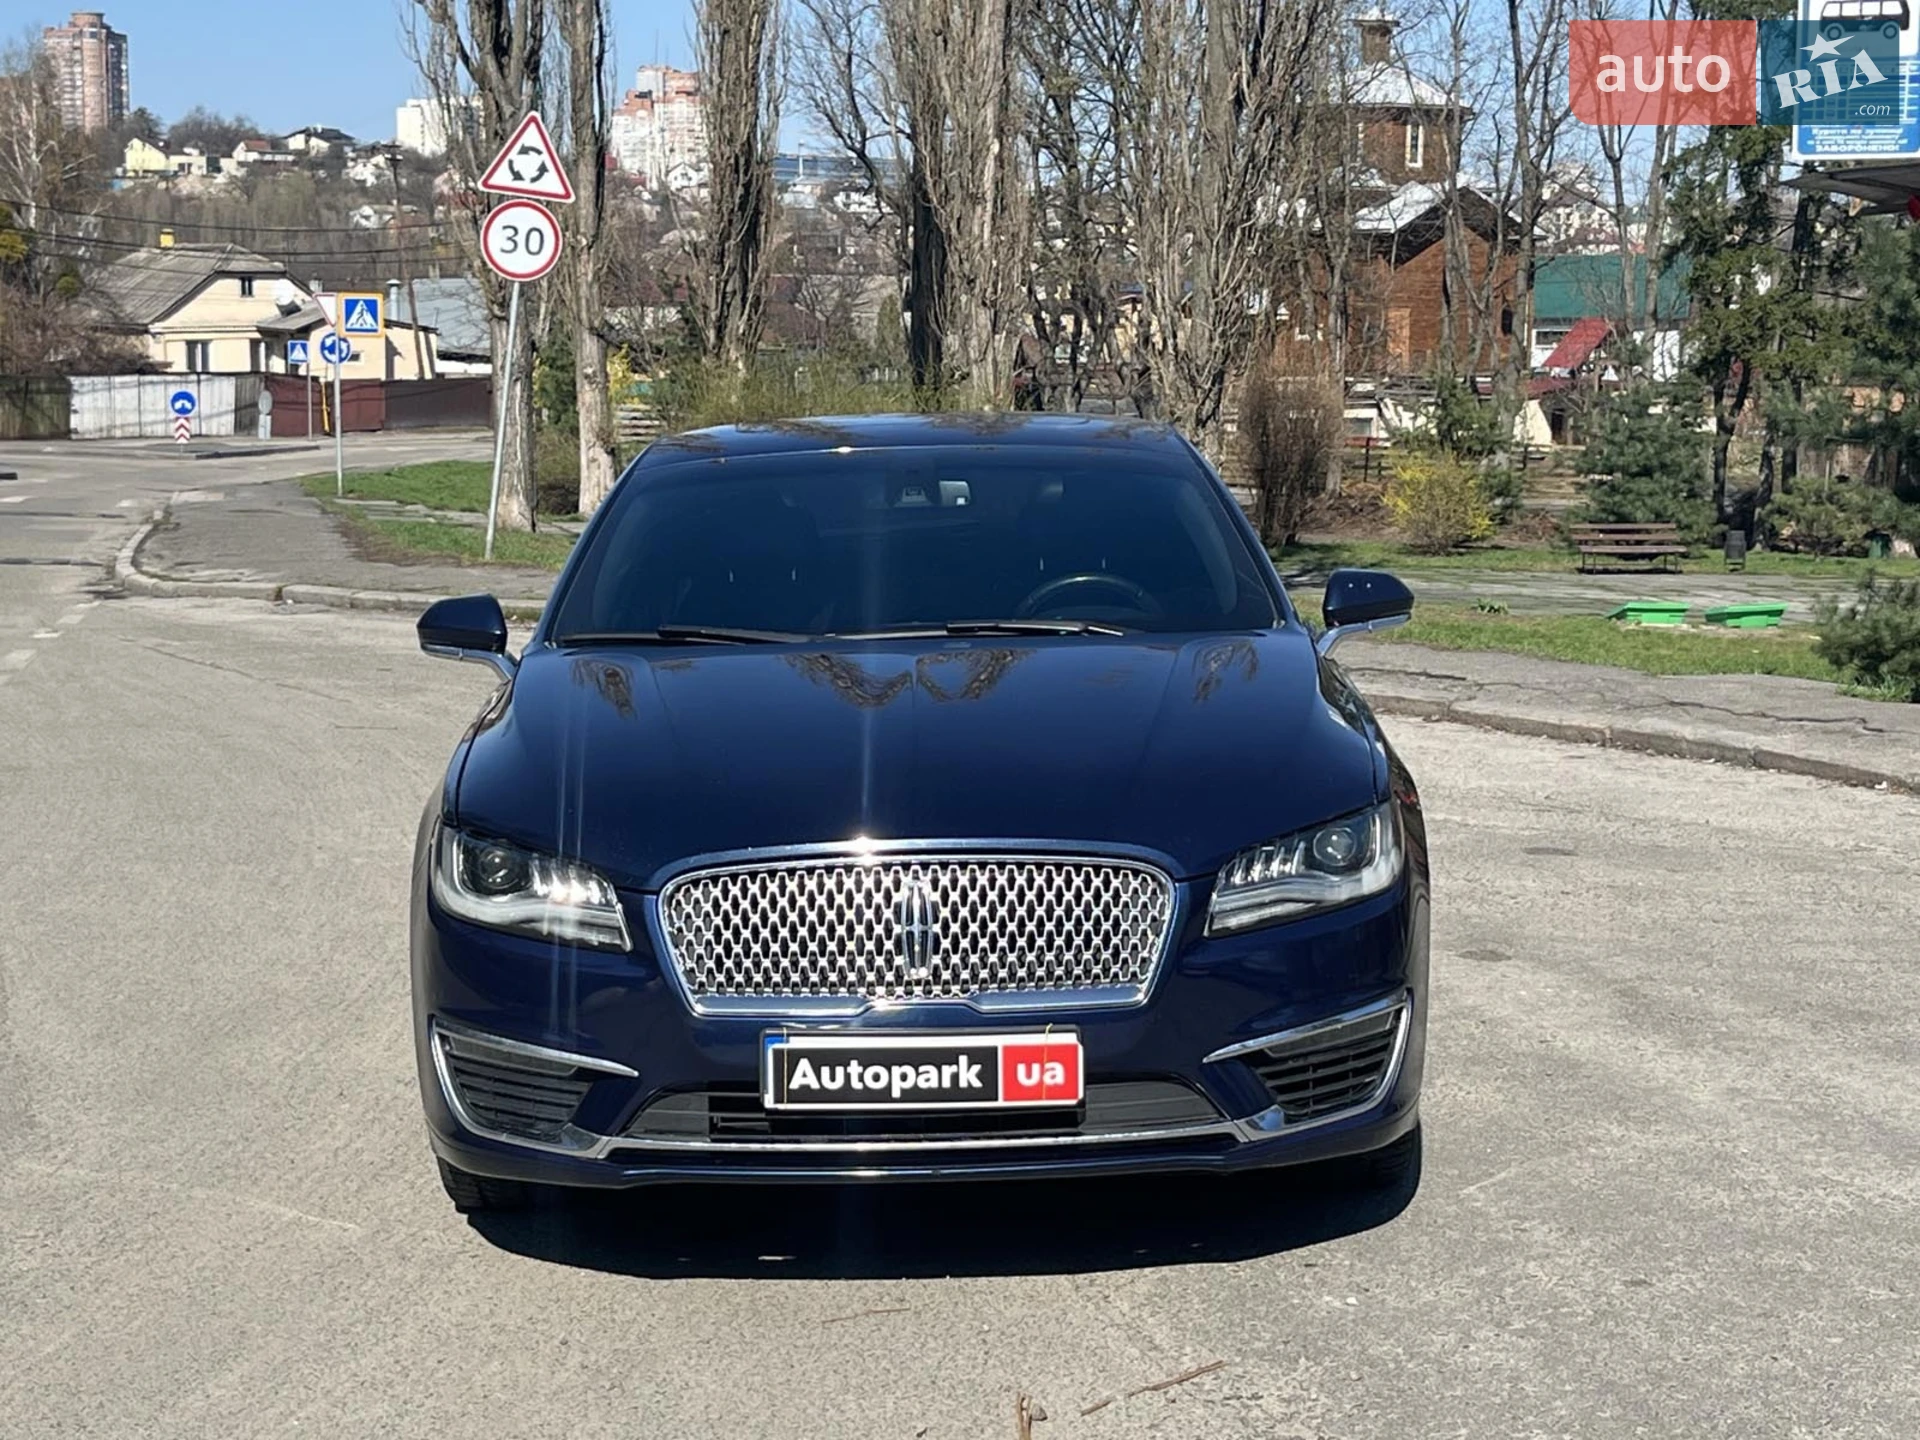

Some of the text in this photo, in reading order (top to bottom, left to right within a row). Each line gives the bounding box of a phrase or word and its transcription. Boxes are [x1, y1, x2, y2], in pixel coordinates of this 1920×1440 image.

[500, 225, 545, 256] 30
[788, 1054, 1066, 1099] Autopark ua
